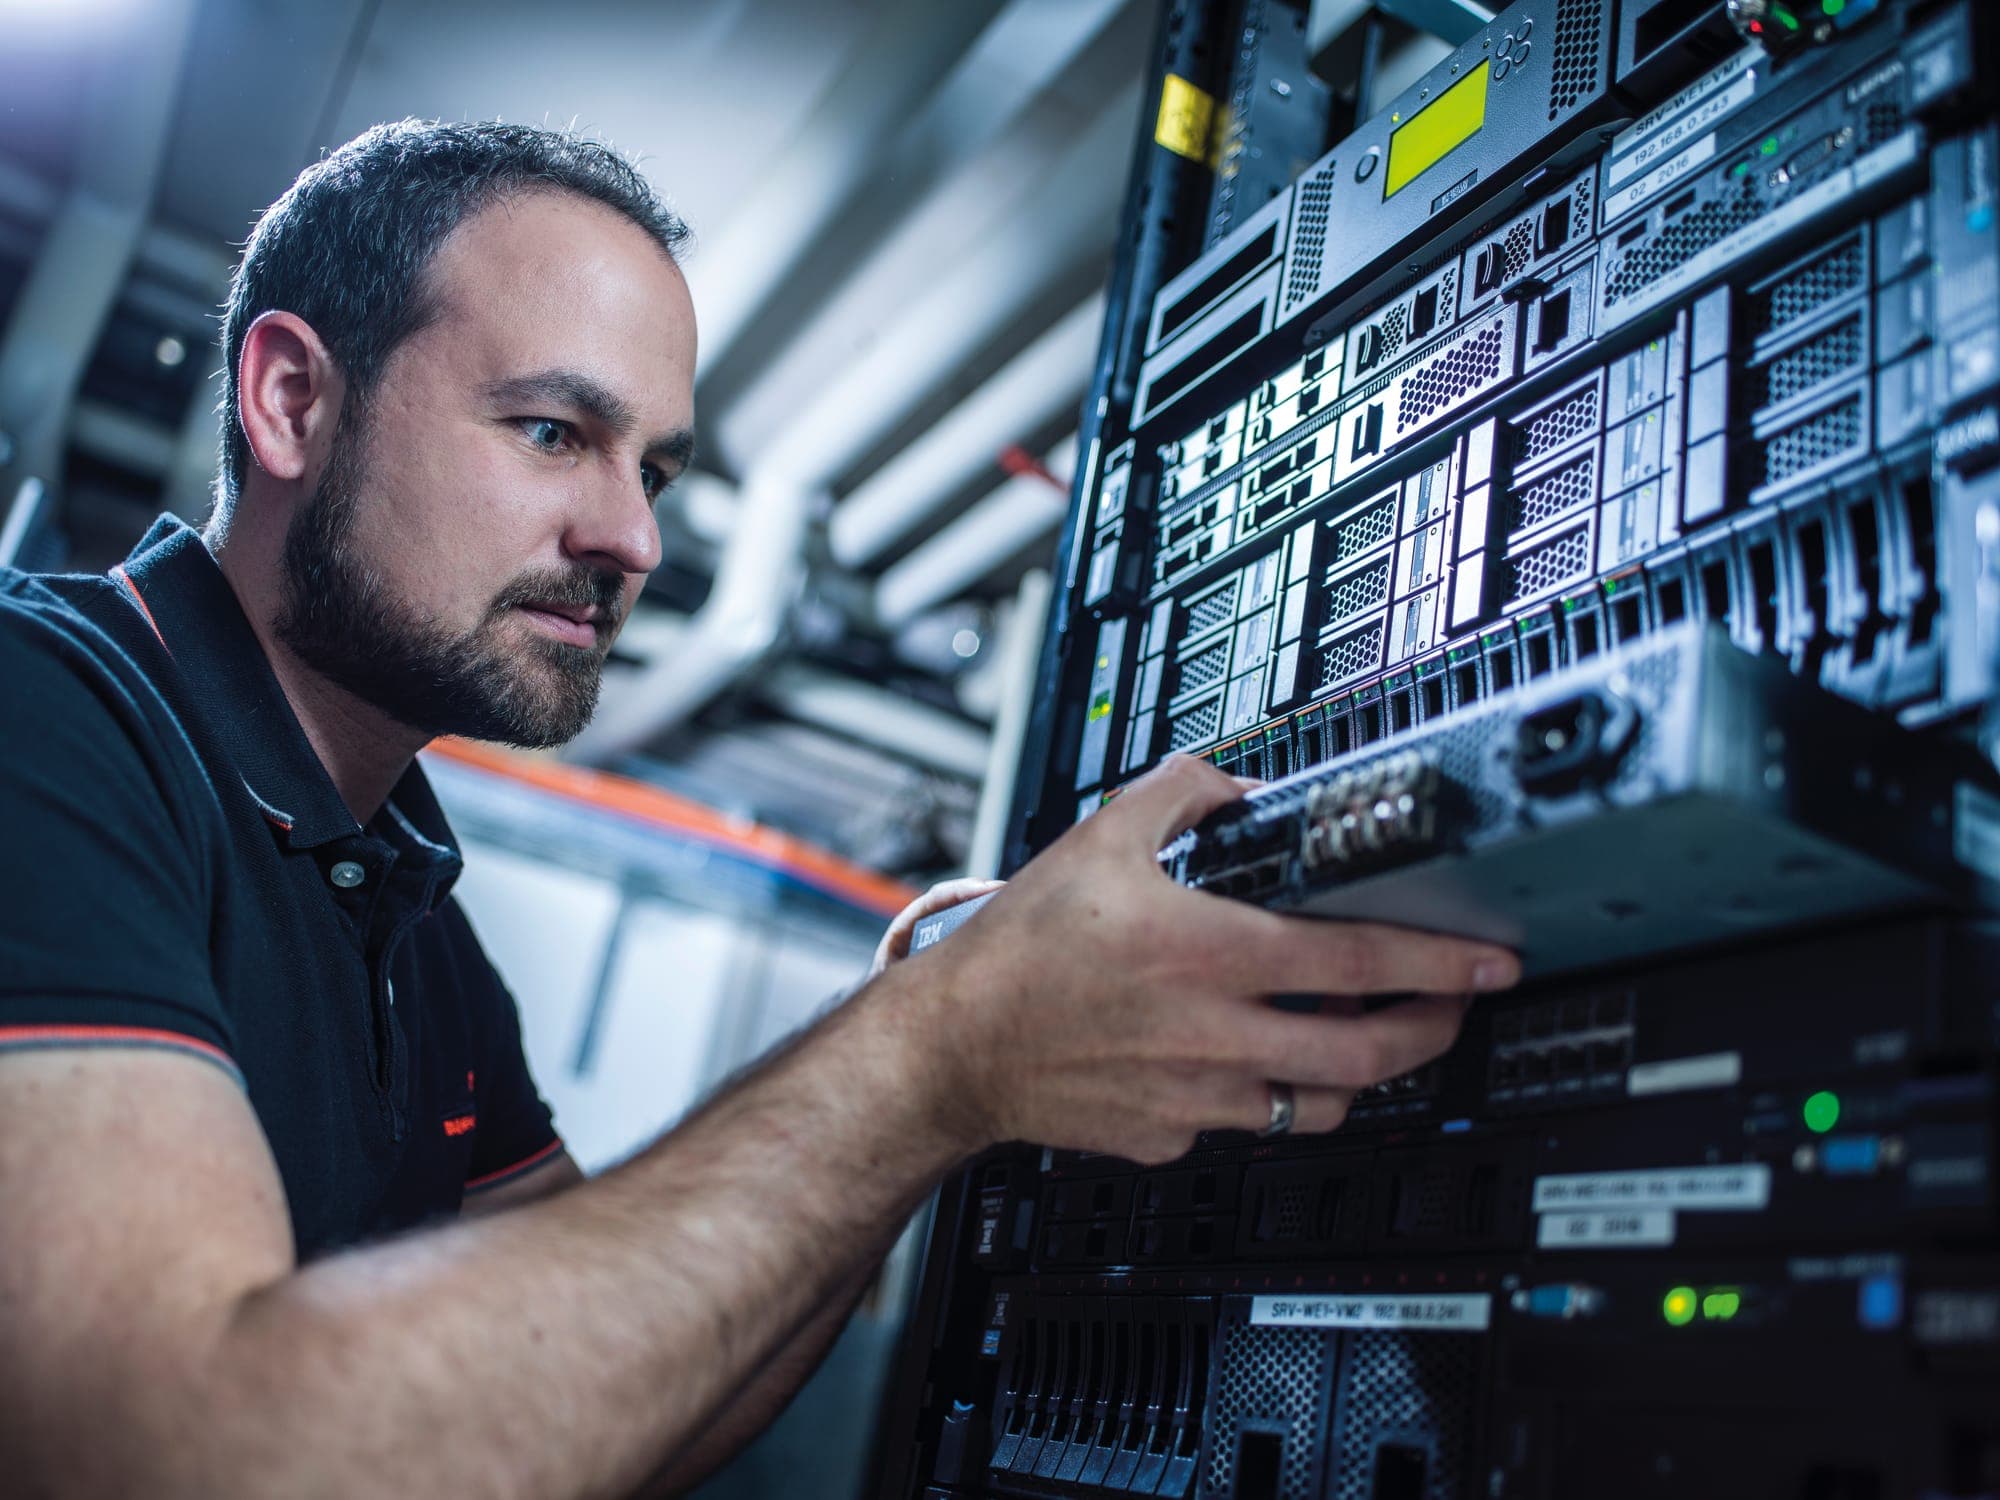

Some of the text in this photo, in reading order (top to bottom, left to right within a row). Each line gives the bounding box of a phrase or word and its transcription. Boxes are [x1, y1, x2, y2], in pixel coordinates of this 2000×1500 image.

[1629, 155, 1690, 201] 02 2016
[917, 921, 943, 949] IBM
